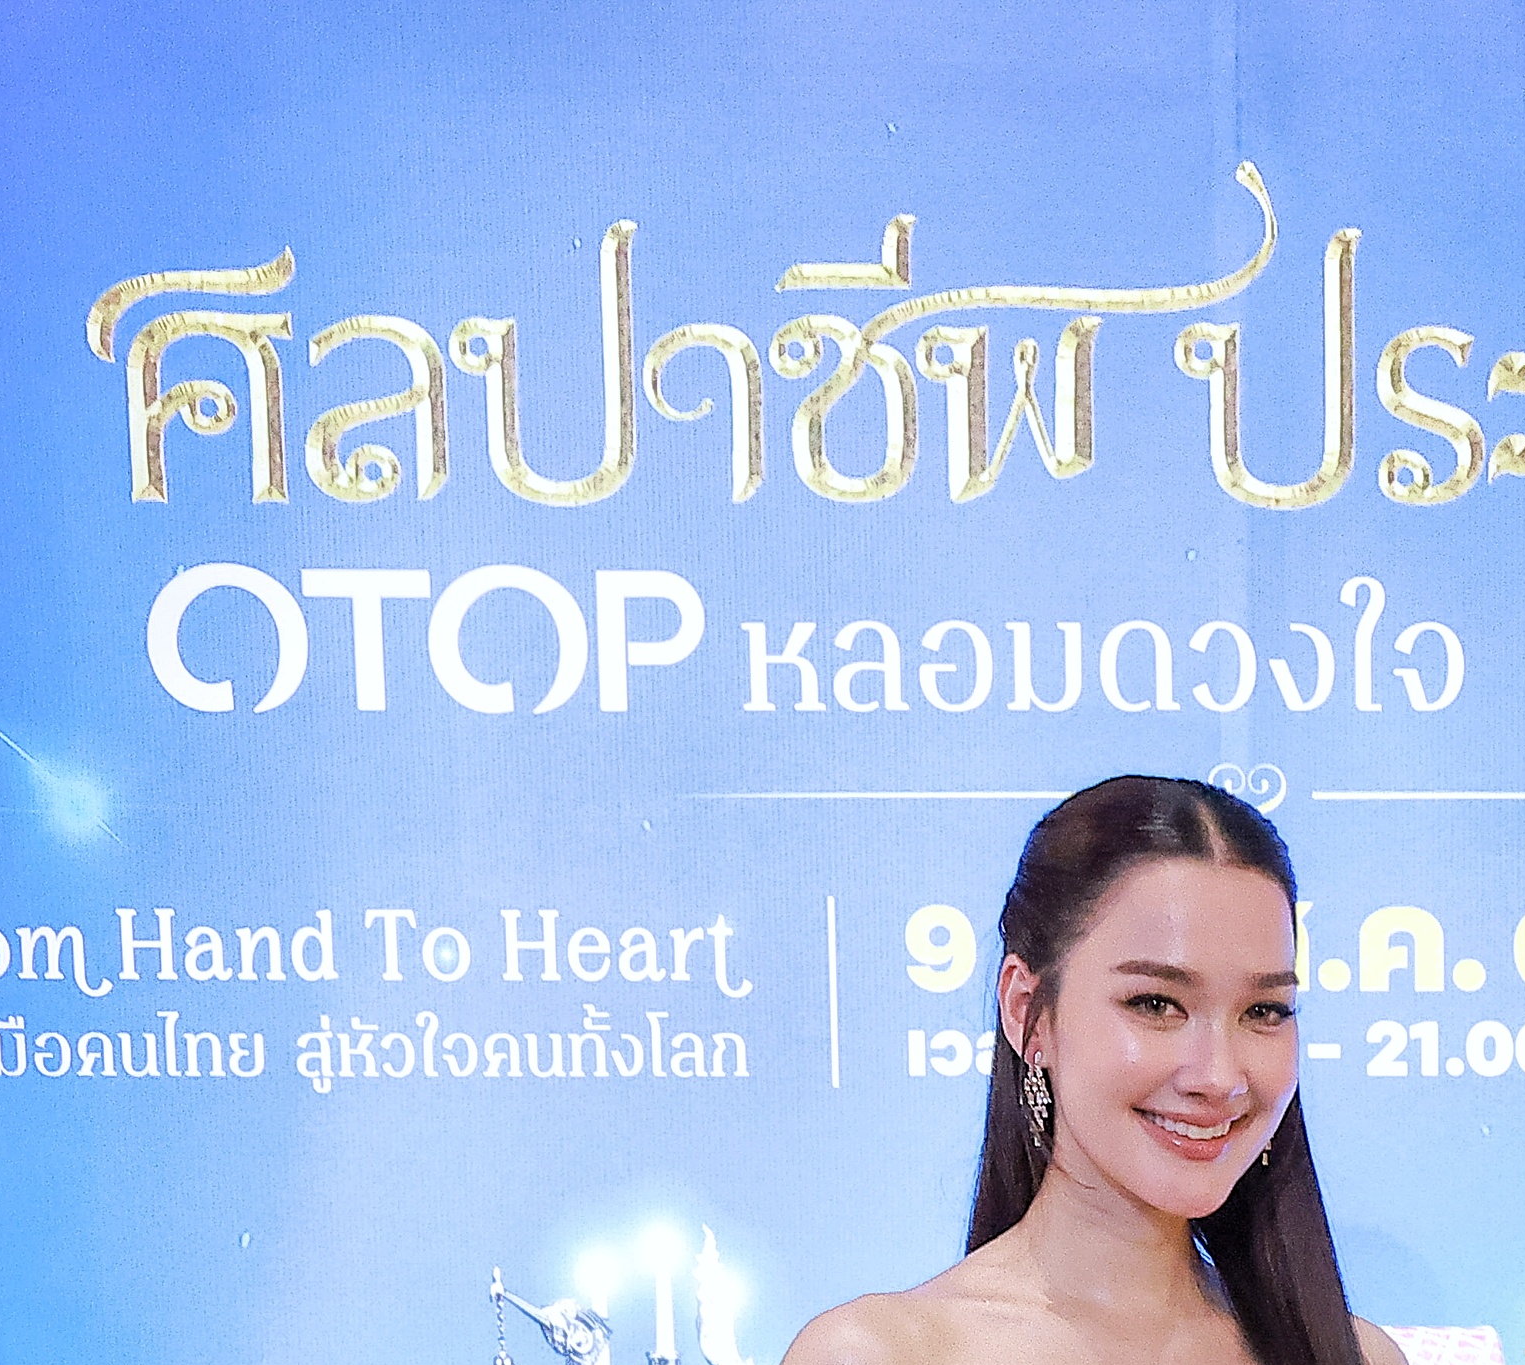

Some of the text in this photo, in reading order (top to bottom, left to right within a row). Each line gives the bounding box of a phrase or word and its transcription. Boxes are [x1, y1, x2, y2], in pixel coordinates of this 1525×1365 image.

[86, 160, 1278, 508] ศิลปาชีพ
[146, 562, 707, 716] OTOP
[740, 576, 1467, 714] หลอมดวงใจ
[116, 907, 338, 983] Hand
[365, 907, 473, 983] To
[500, 906, 753, 998] Heart
[904, 904, 976, 993] 9
[1294, 900, 1487, 994] .ค.
[296, 1003, 749, 1094] สู่หัวใจคนทั้งโลก
